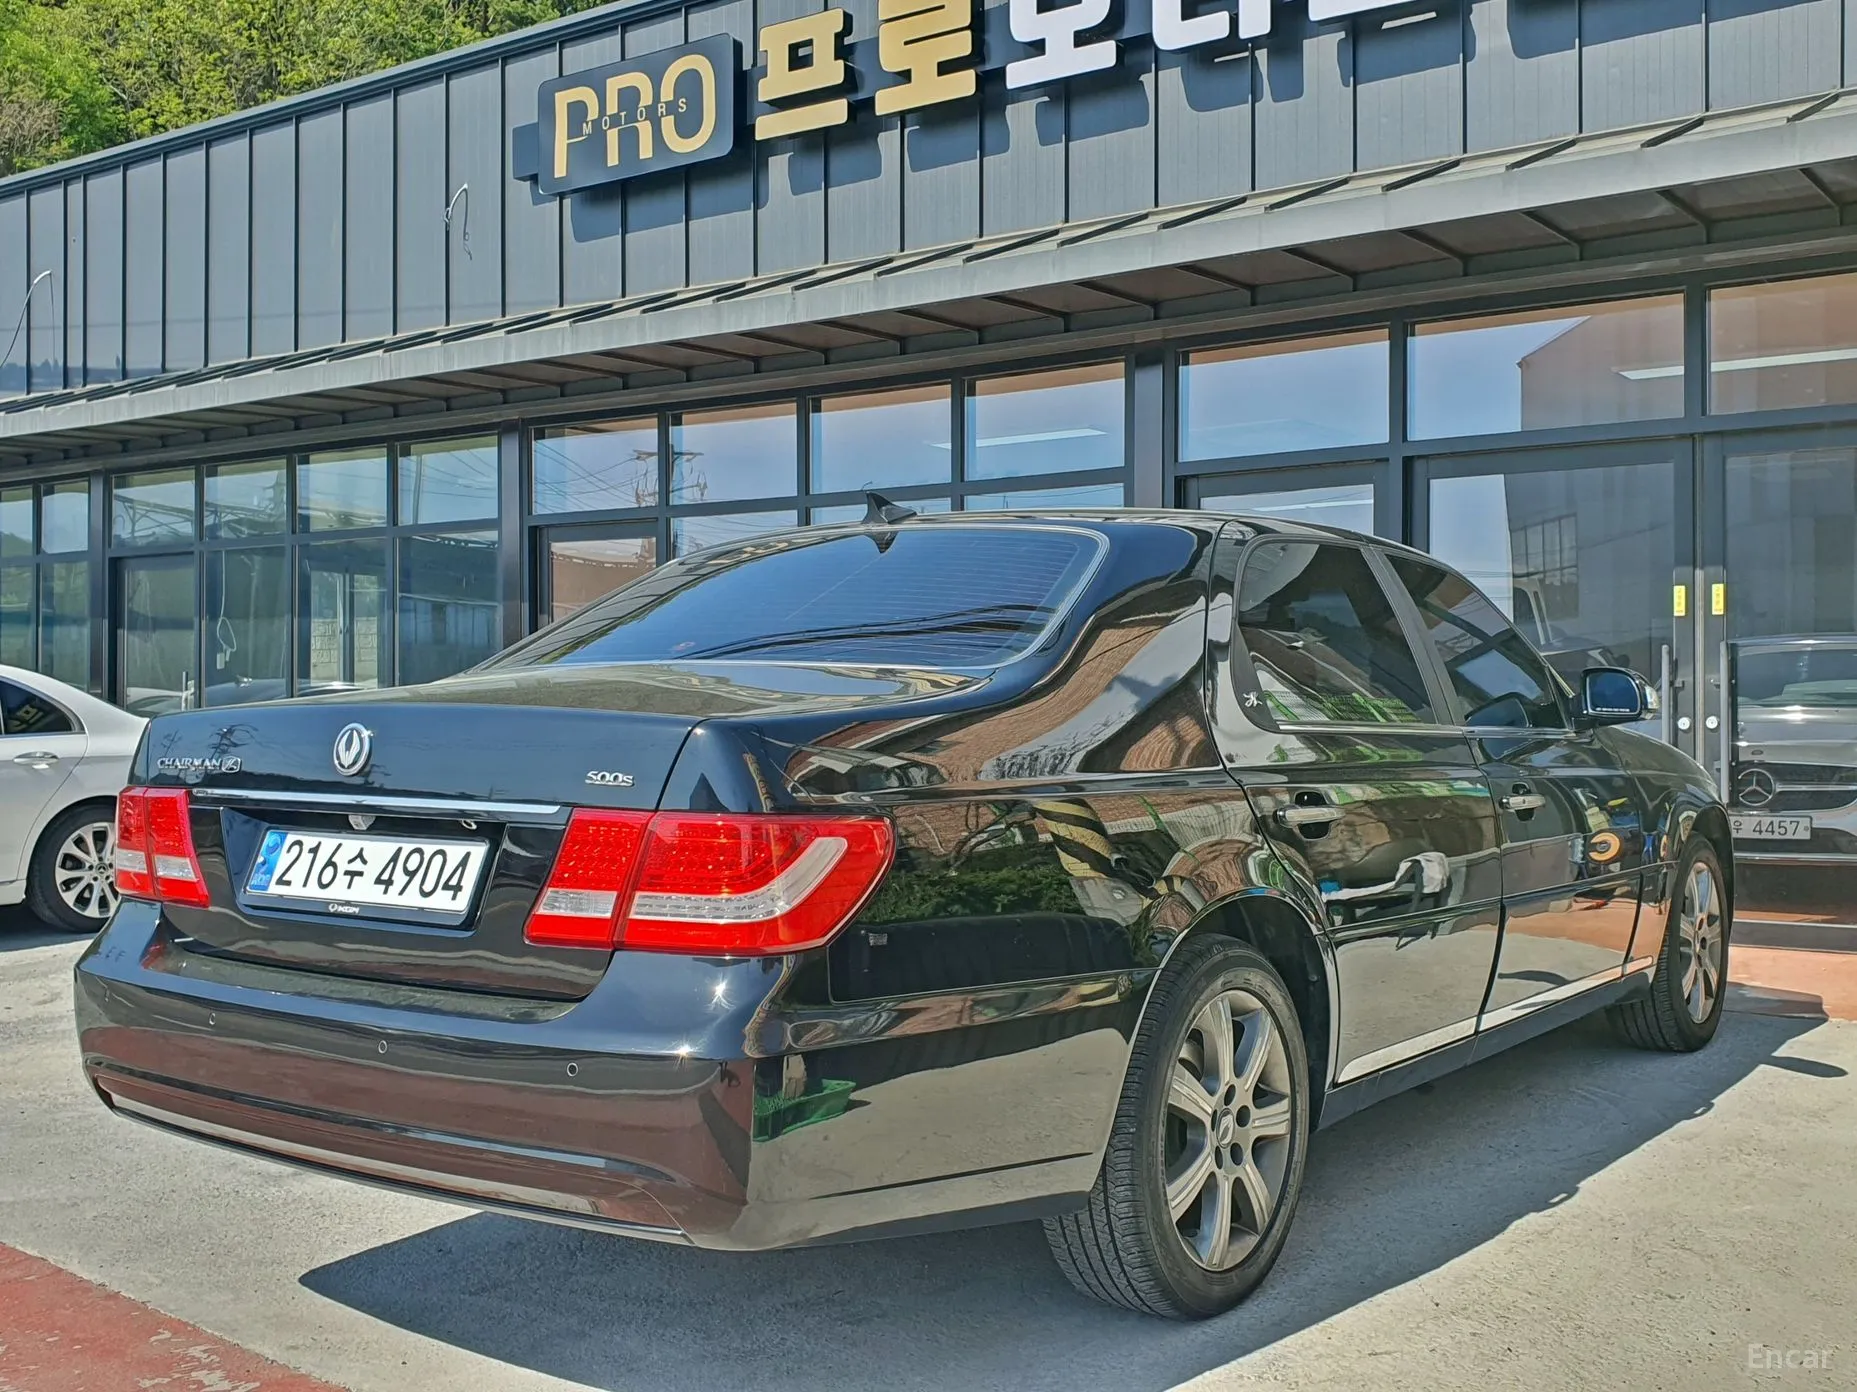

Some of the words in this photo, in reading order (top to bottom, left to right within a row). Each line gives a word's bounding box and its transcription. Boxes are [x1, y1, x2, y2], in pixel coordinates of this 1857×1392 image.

[755, 0, 1414, 141] 프로모
[553, 53, 716, 179] PRO
[582, 97, 688, 136] MOTORS
[157, 757, 221, 771] CHAIRMAN
[1752, 820, 1801, 836] 4457
[275, 839, 369, 890] 216수
[373, 846, 472, 901] 4904
